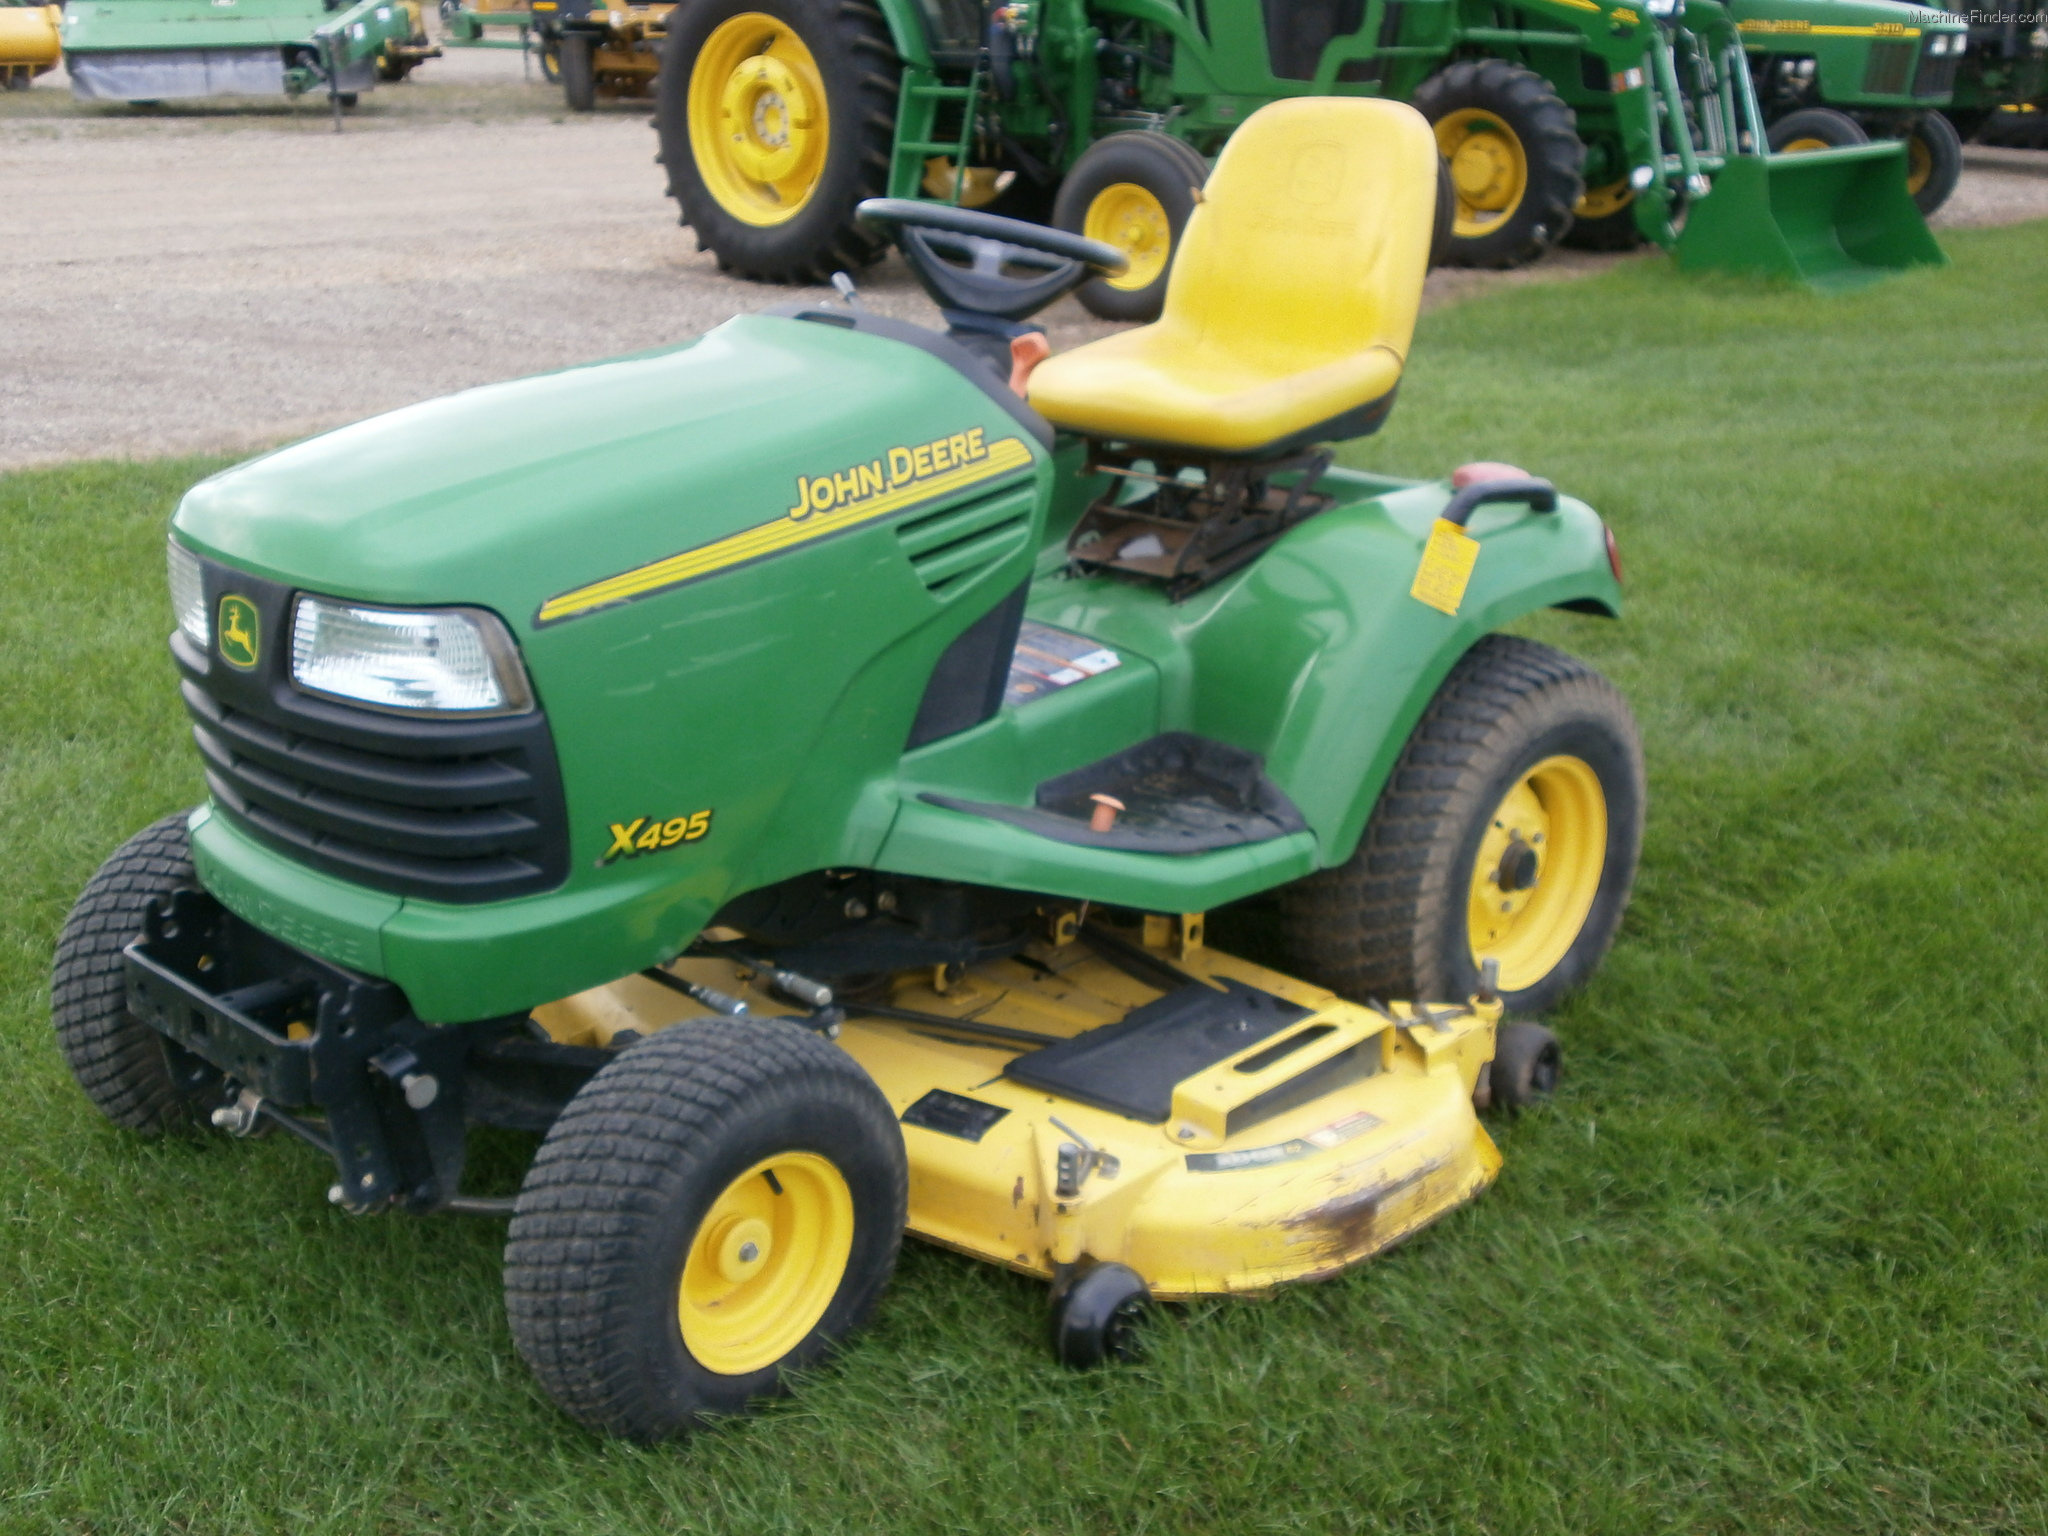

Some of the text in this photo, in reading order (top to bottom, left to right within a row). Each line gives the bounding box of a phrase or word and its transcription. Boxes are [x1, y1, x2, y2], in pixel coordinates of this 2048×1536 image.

[789, 426, 987, 520] JOHN DEERE
[602, 809, 713, 862] X495
